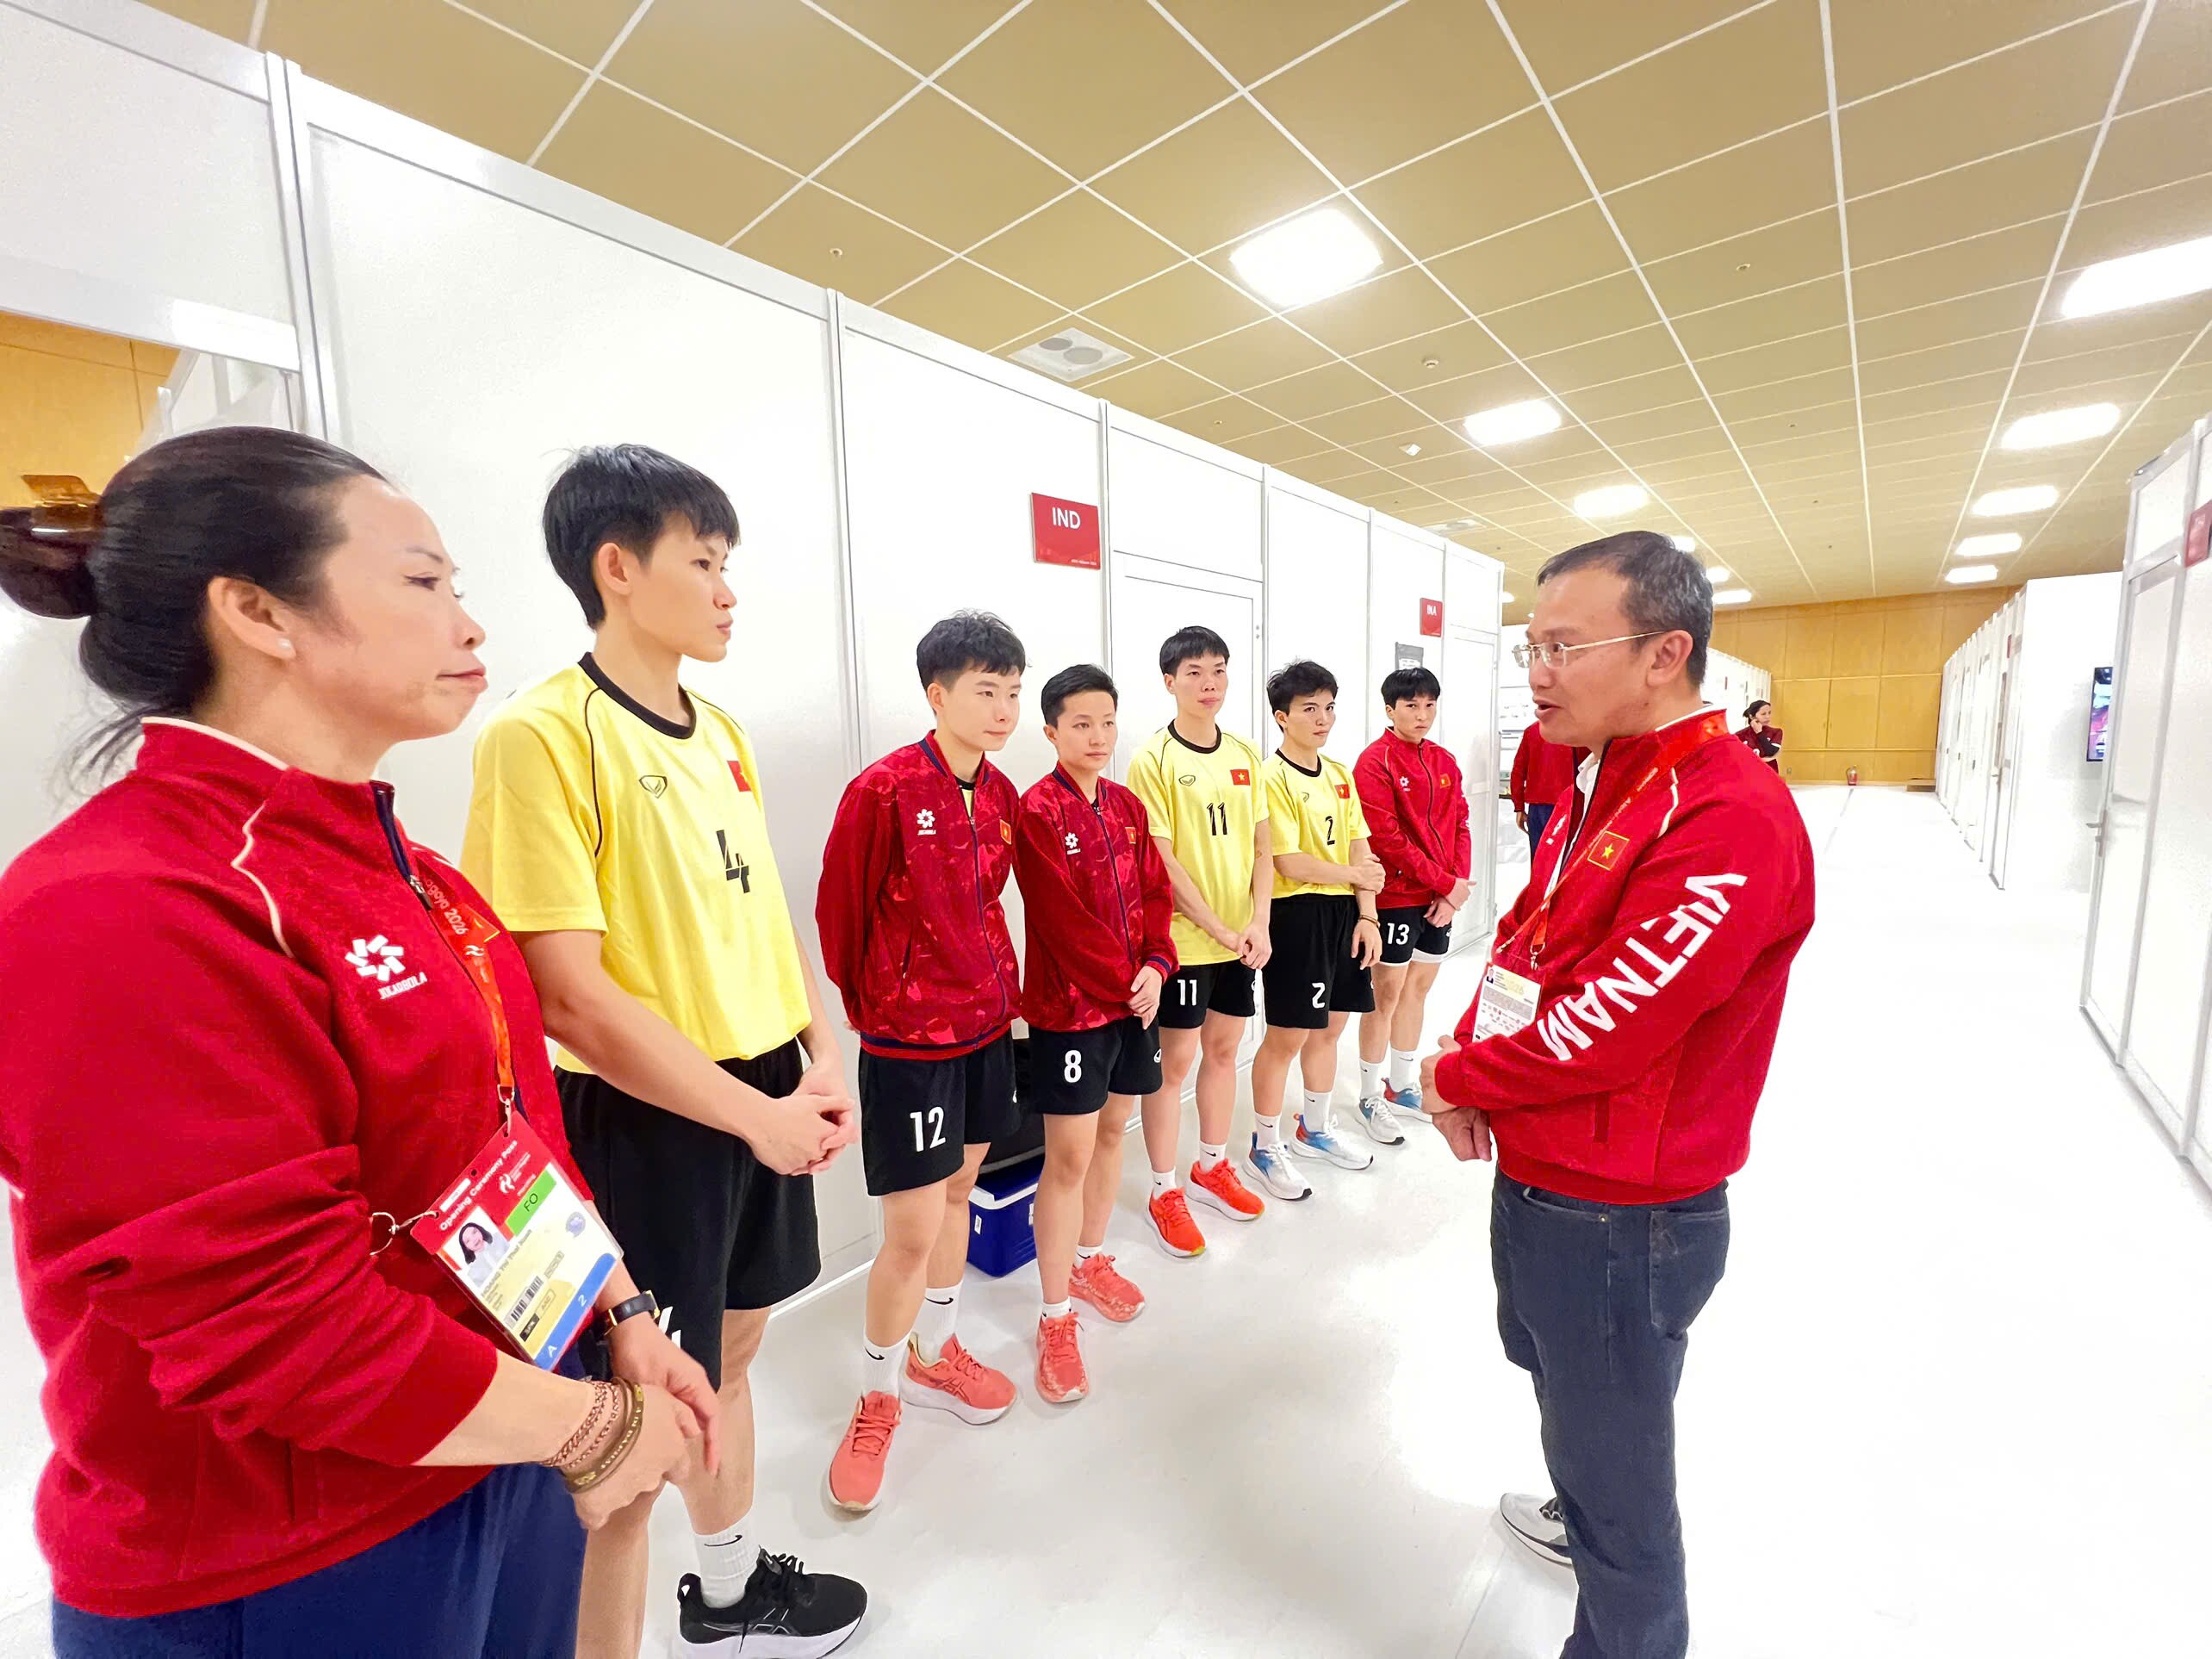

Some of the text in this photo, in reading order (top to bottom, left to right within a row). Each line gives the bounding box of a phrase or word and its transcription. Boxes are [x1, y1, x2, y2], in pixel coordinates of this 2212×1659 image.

[1052, 506, 1081, 529] IND
[1206, 802, 1228, 836] 11
[1324, 816, 1335, 846] 2
[716, 829, 750, 894] 4
[426, 879, 469, 935] agoya 2026
[1387, 923, 1410, 946] 13
[1537, 873, 1748, 1061] VIETNAM
[1177, 979, 1197, 1006] 11
[1312, 982, 1326, 1009] 2
[1064, 1050, 1082, 1083] 8
[910, 1106, 946, 1153] 12
[439, 1140, 518, 1231] Opening Ceremony Pass
[524, 1193, 538, 1212] FO
[547, 1294, 587, 1358] A 2
